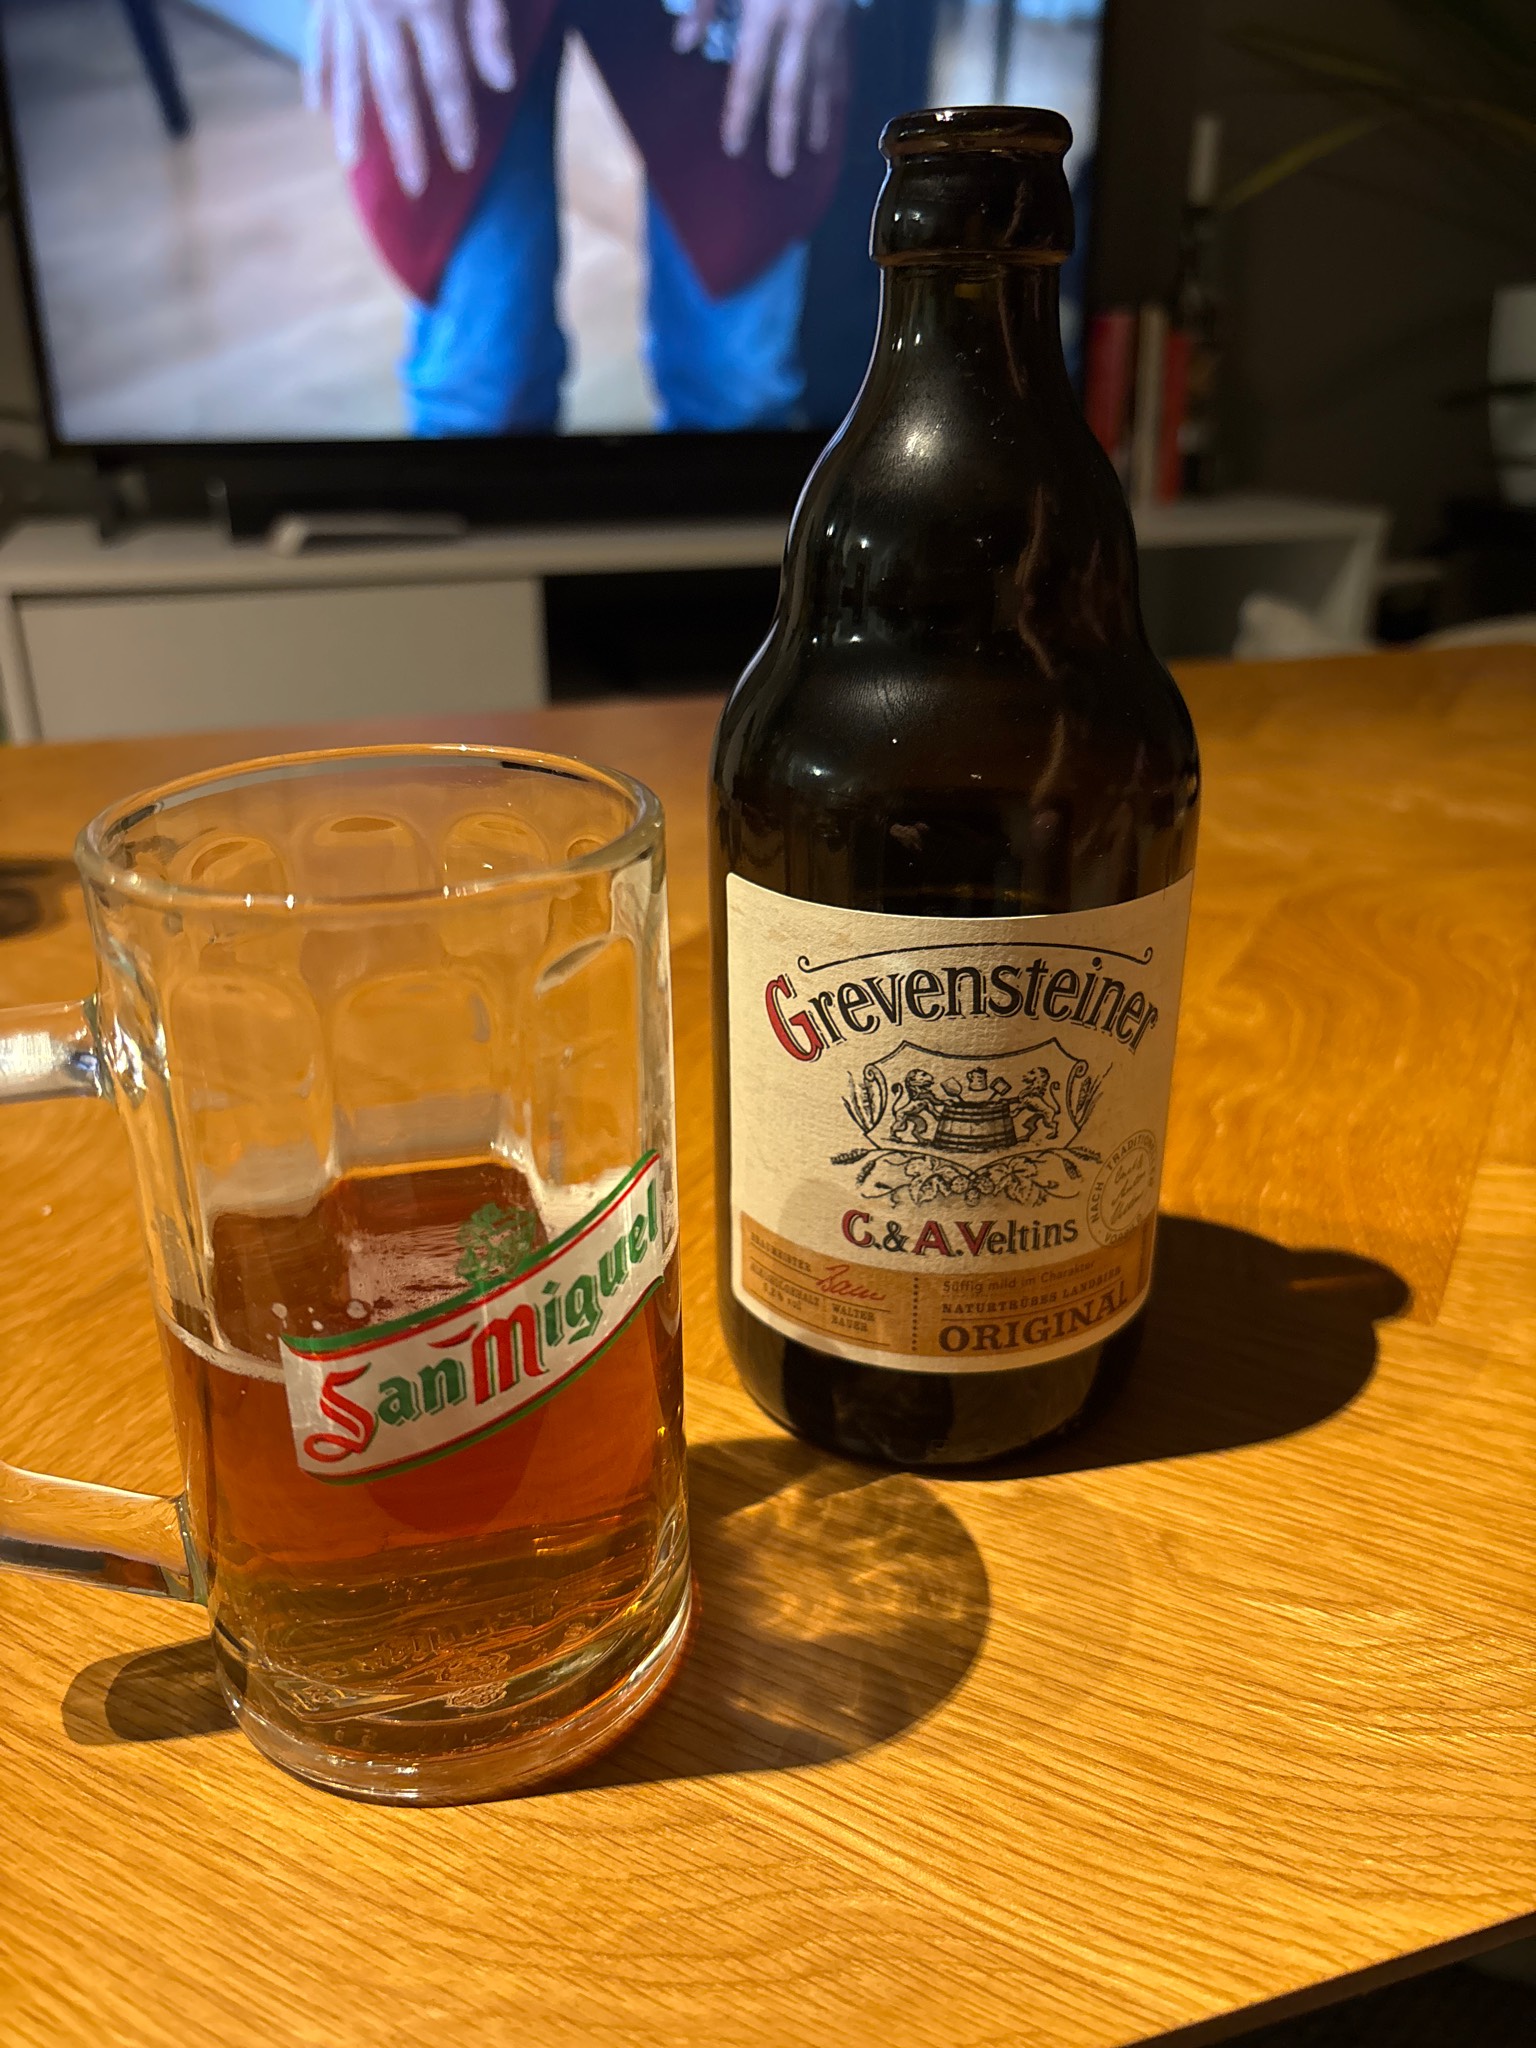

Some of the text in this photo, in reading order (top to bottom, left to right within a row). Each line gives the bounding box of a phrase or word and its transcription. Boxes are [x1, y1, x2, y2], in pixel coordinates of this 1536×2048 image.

[765, 957, 1158, 1062] Grevensteiner
[1090, 1182, 1105, 1223] NACH
[941, 1265, 1122, 1315] NATURTRÜBES LANDBIER
[942, 1260, 1096, 1295] Süffig mild im Charakter
[304, 1178, 659, 1463] San Miguel
[831, 1302, 876, 1322] WALTER
[831, 1314, 869, 1332] BAUER
[938, 1279, 1129, 1352] ORIGINAL
